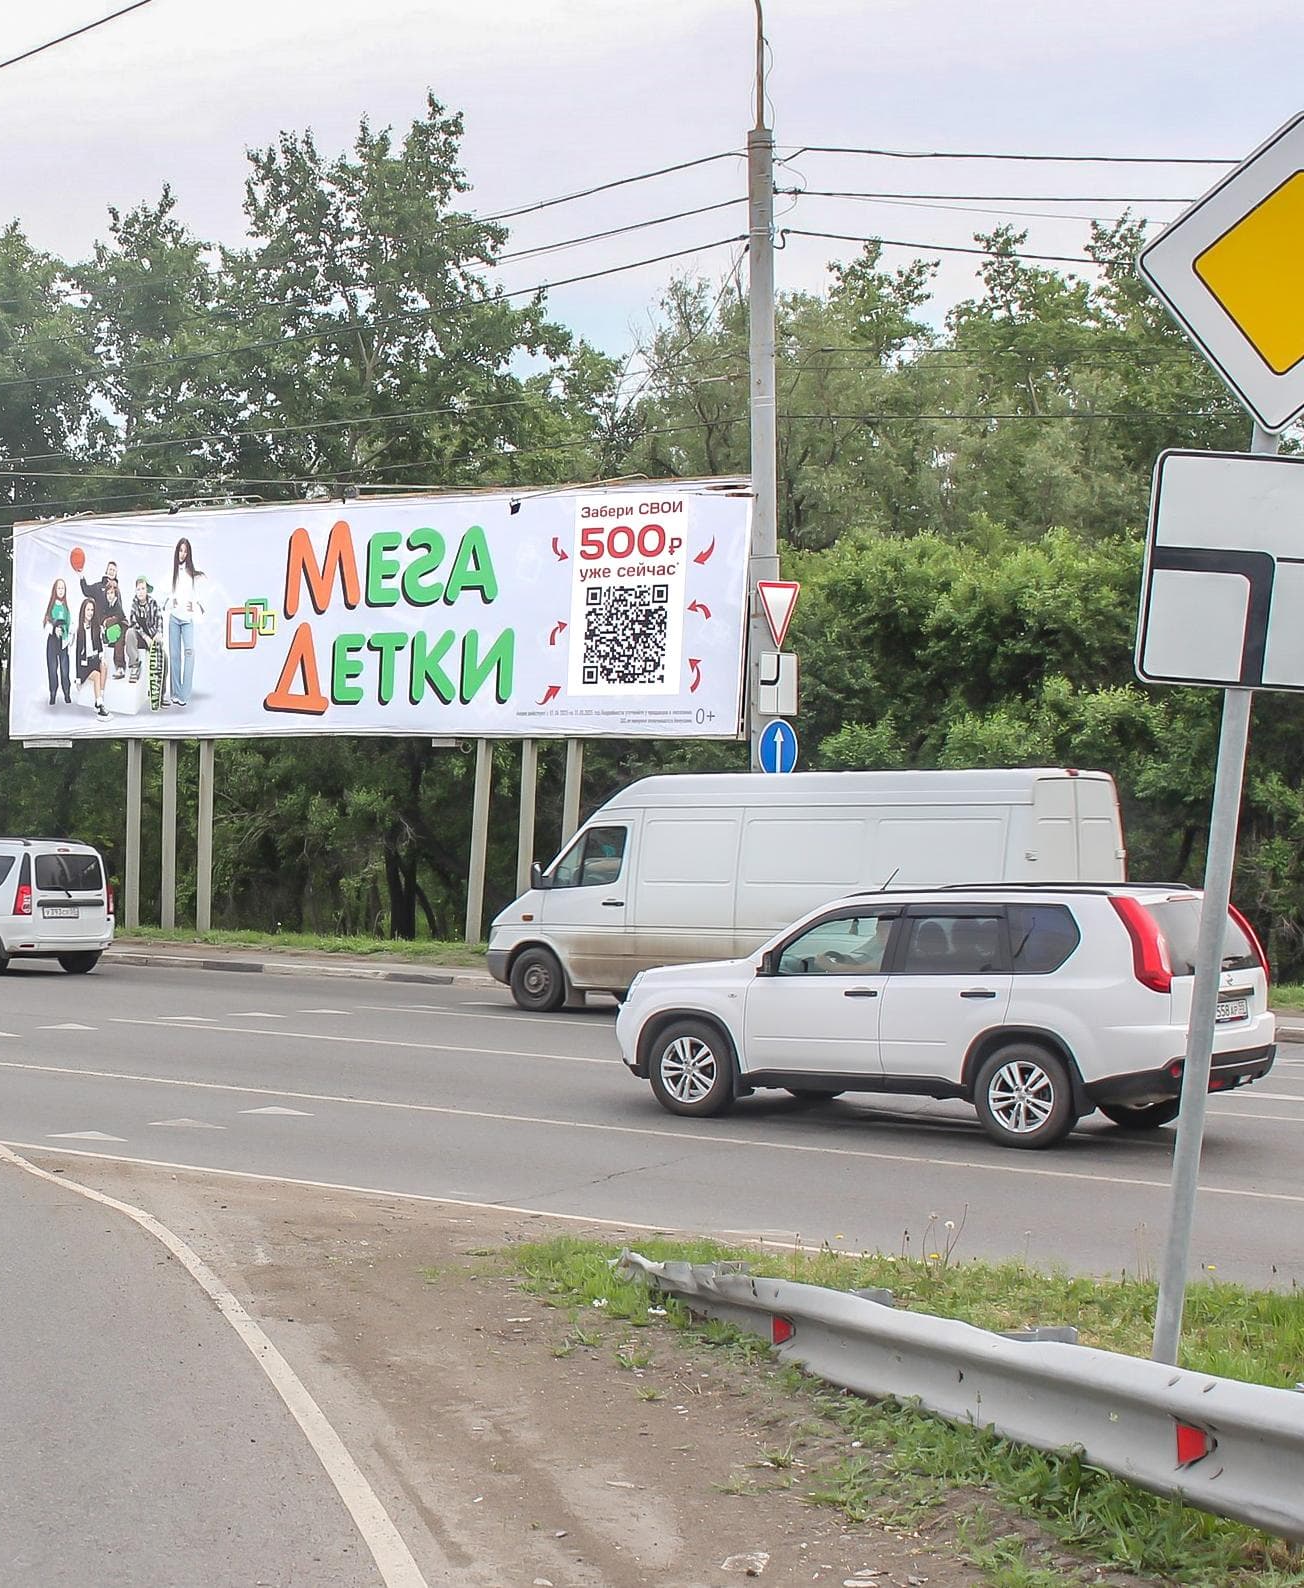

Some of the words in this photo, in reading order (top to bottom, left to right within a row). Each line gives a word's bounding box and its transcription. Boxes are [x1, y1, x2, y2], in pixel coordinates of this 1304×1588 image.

[581, 505, 634, 519] Забери
[639, 500, 683, 515] СВОИ
[579, 567, 611, 582] уже
[263, 621, 516, 716] ДЕТКИ
[695, 707, 716, 725] 0+
[1216, 1004, 1238, 1017] 558АР
